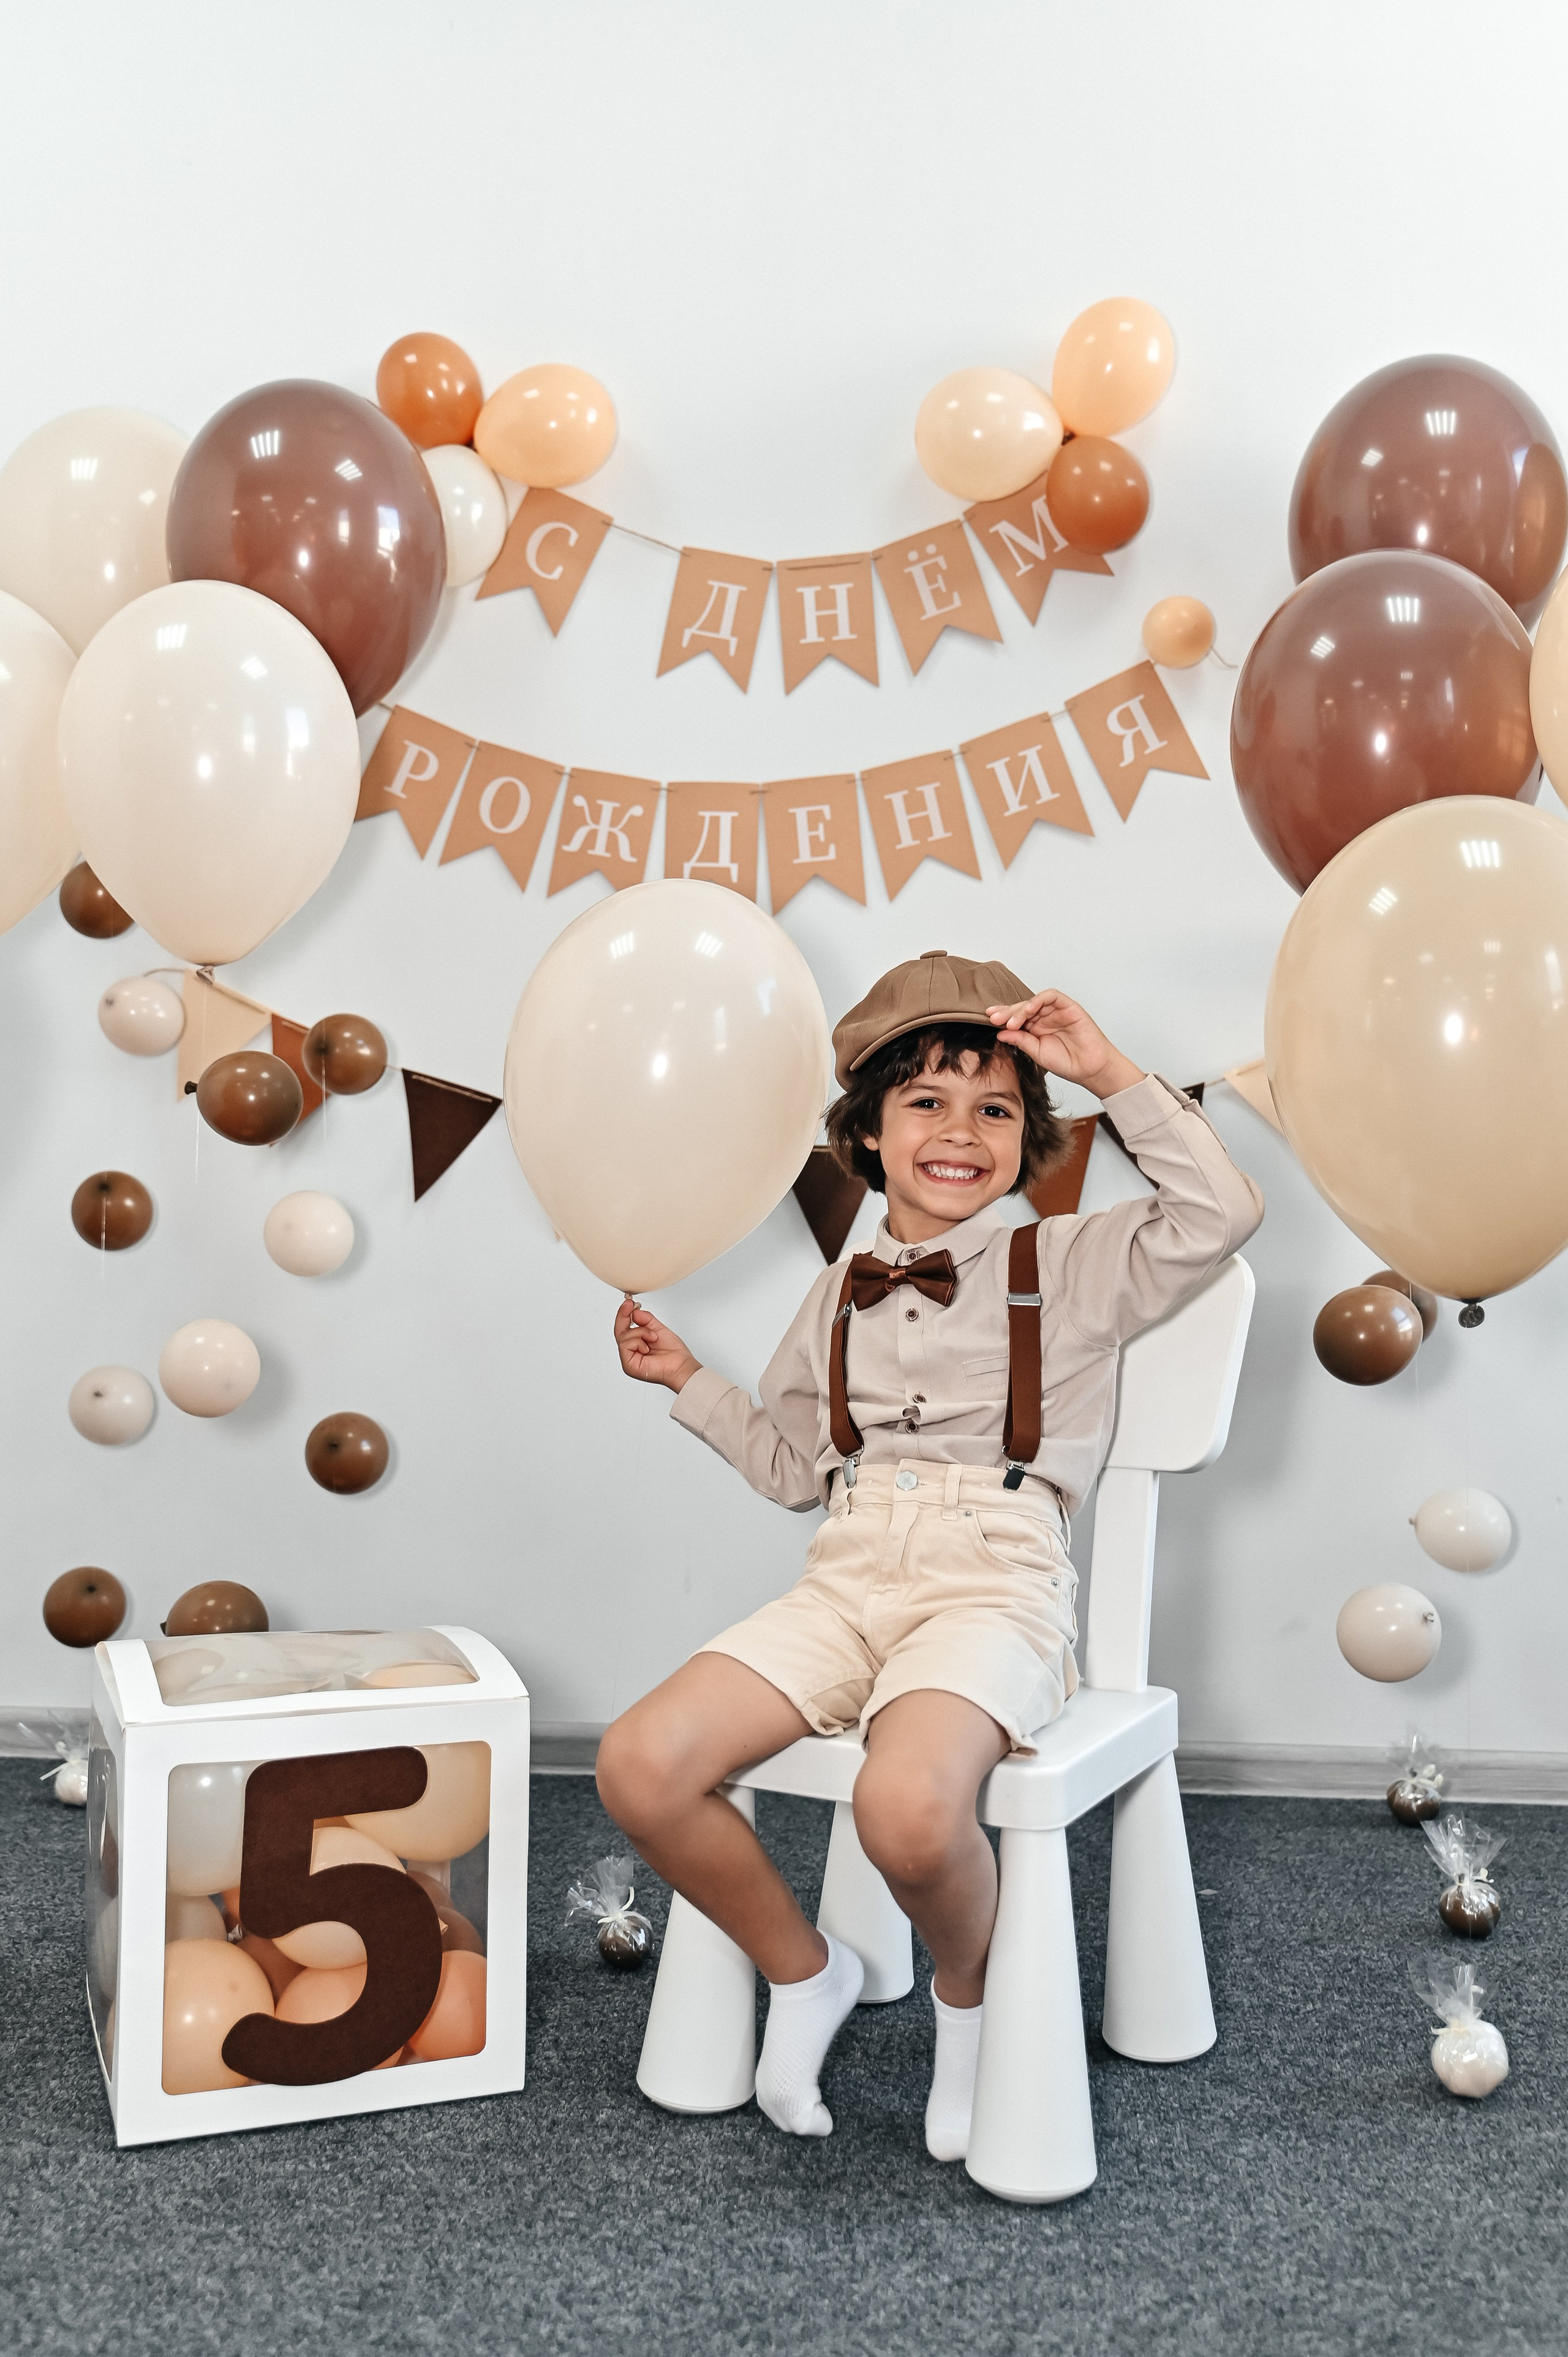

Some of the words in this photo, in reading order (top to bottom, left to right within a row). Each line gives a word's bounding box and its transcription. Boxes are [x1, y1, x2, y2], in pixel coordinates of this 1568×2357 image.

[525, 521, 579, 581] С
[682, 495, 1069, 657] ДНЁМ
[384, 695, 1167, 883] РОЖДЕНИЯ
[221, 1746, 443, 2086] 5
